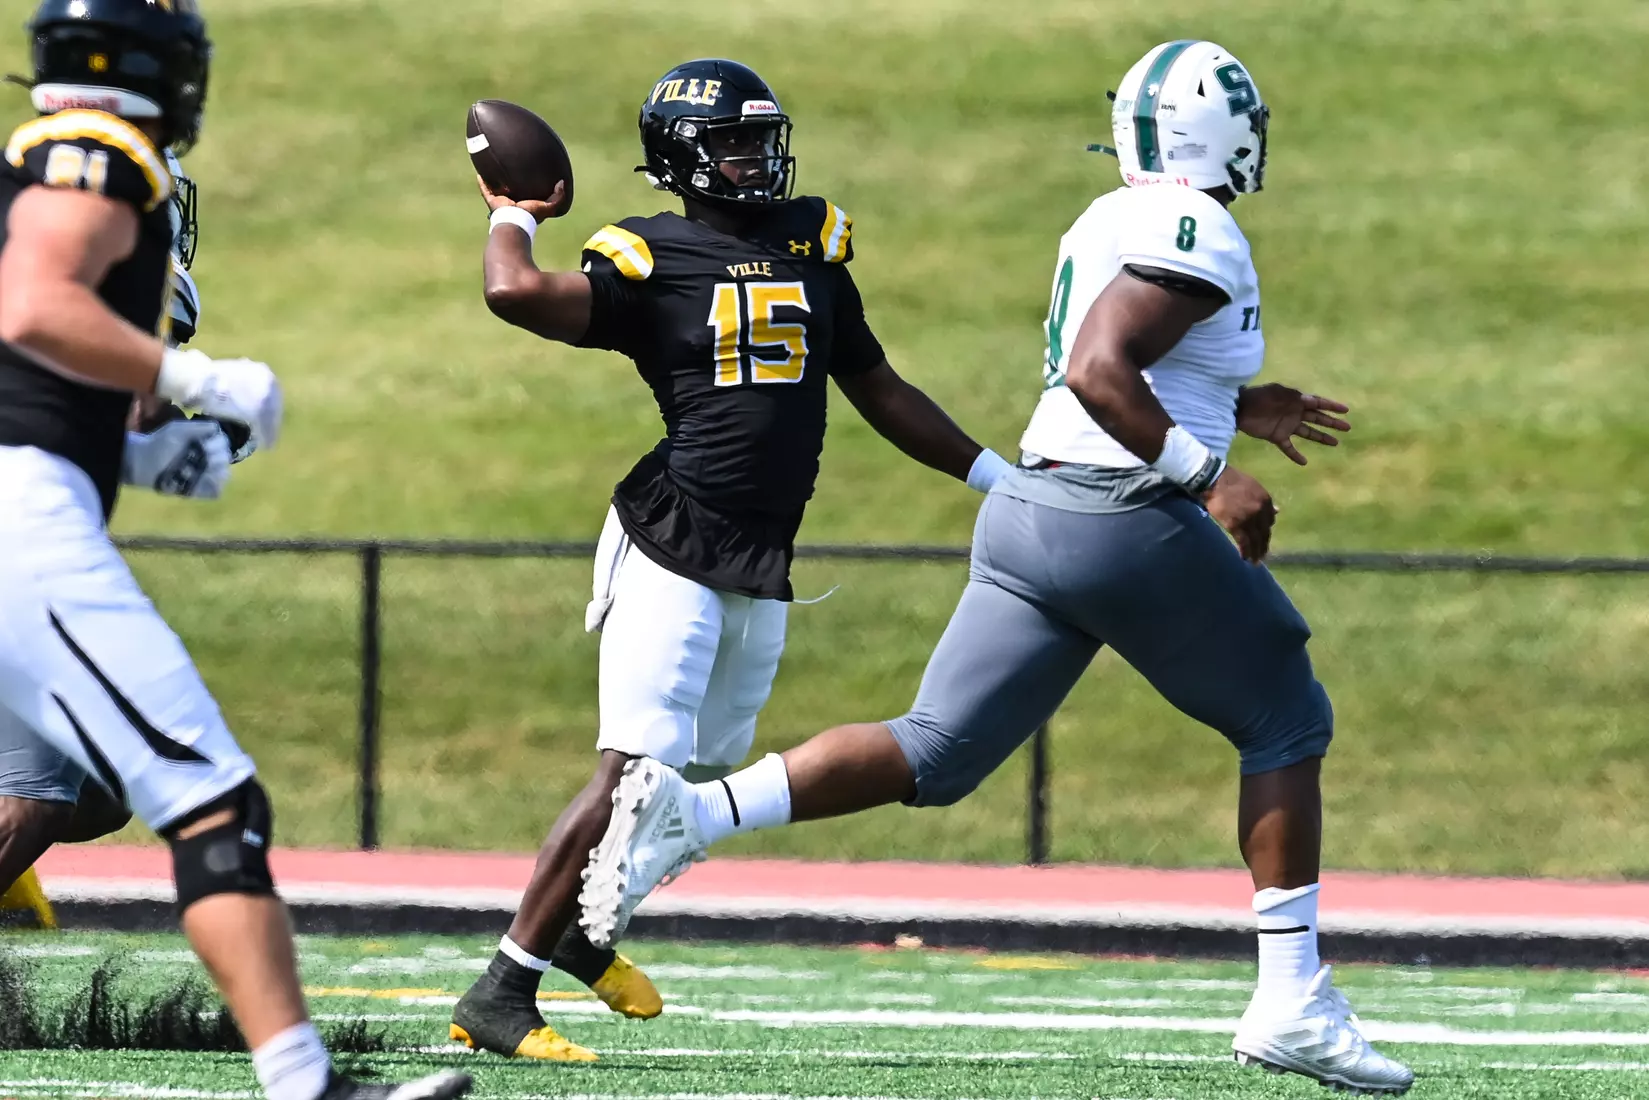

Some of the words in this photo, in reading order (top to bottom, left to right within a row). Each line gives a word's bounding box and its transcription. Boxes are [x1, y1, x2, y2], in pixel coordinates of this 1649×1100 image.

[651, 78, 722, 106] VILLE
[1213, 61, 1257, 118] S
[1176, 215, 1197, 252] 8
[726, 261, 773, 278] VILLE
[707, 281, 812, 386] 15
